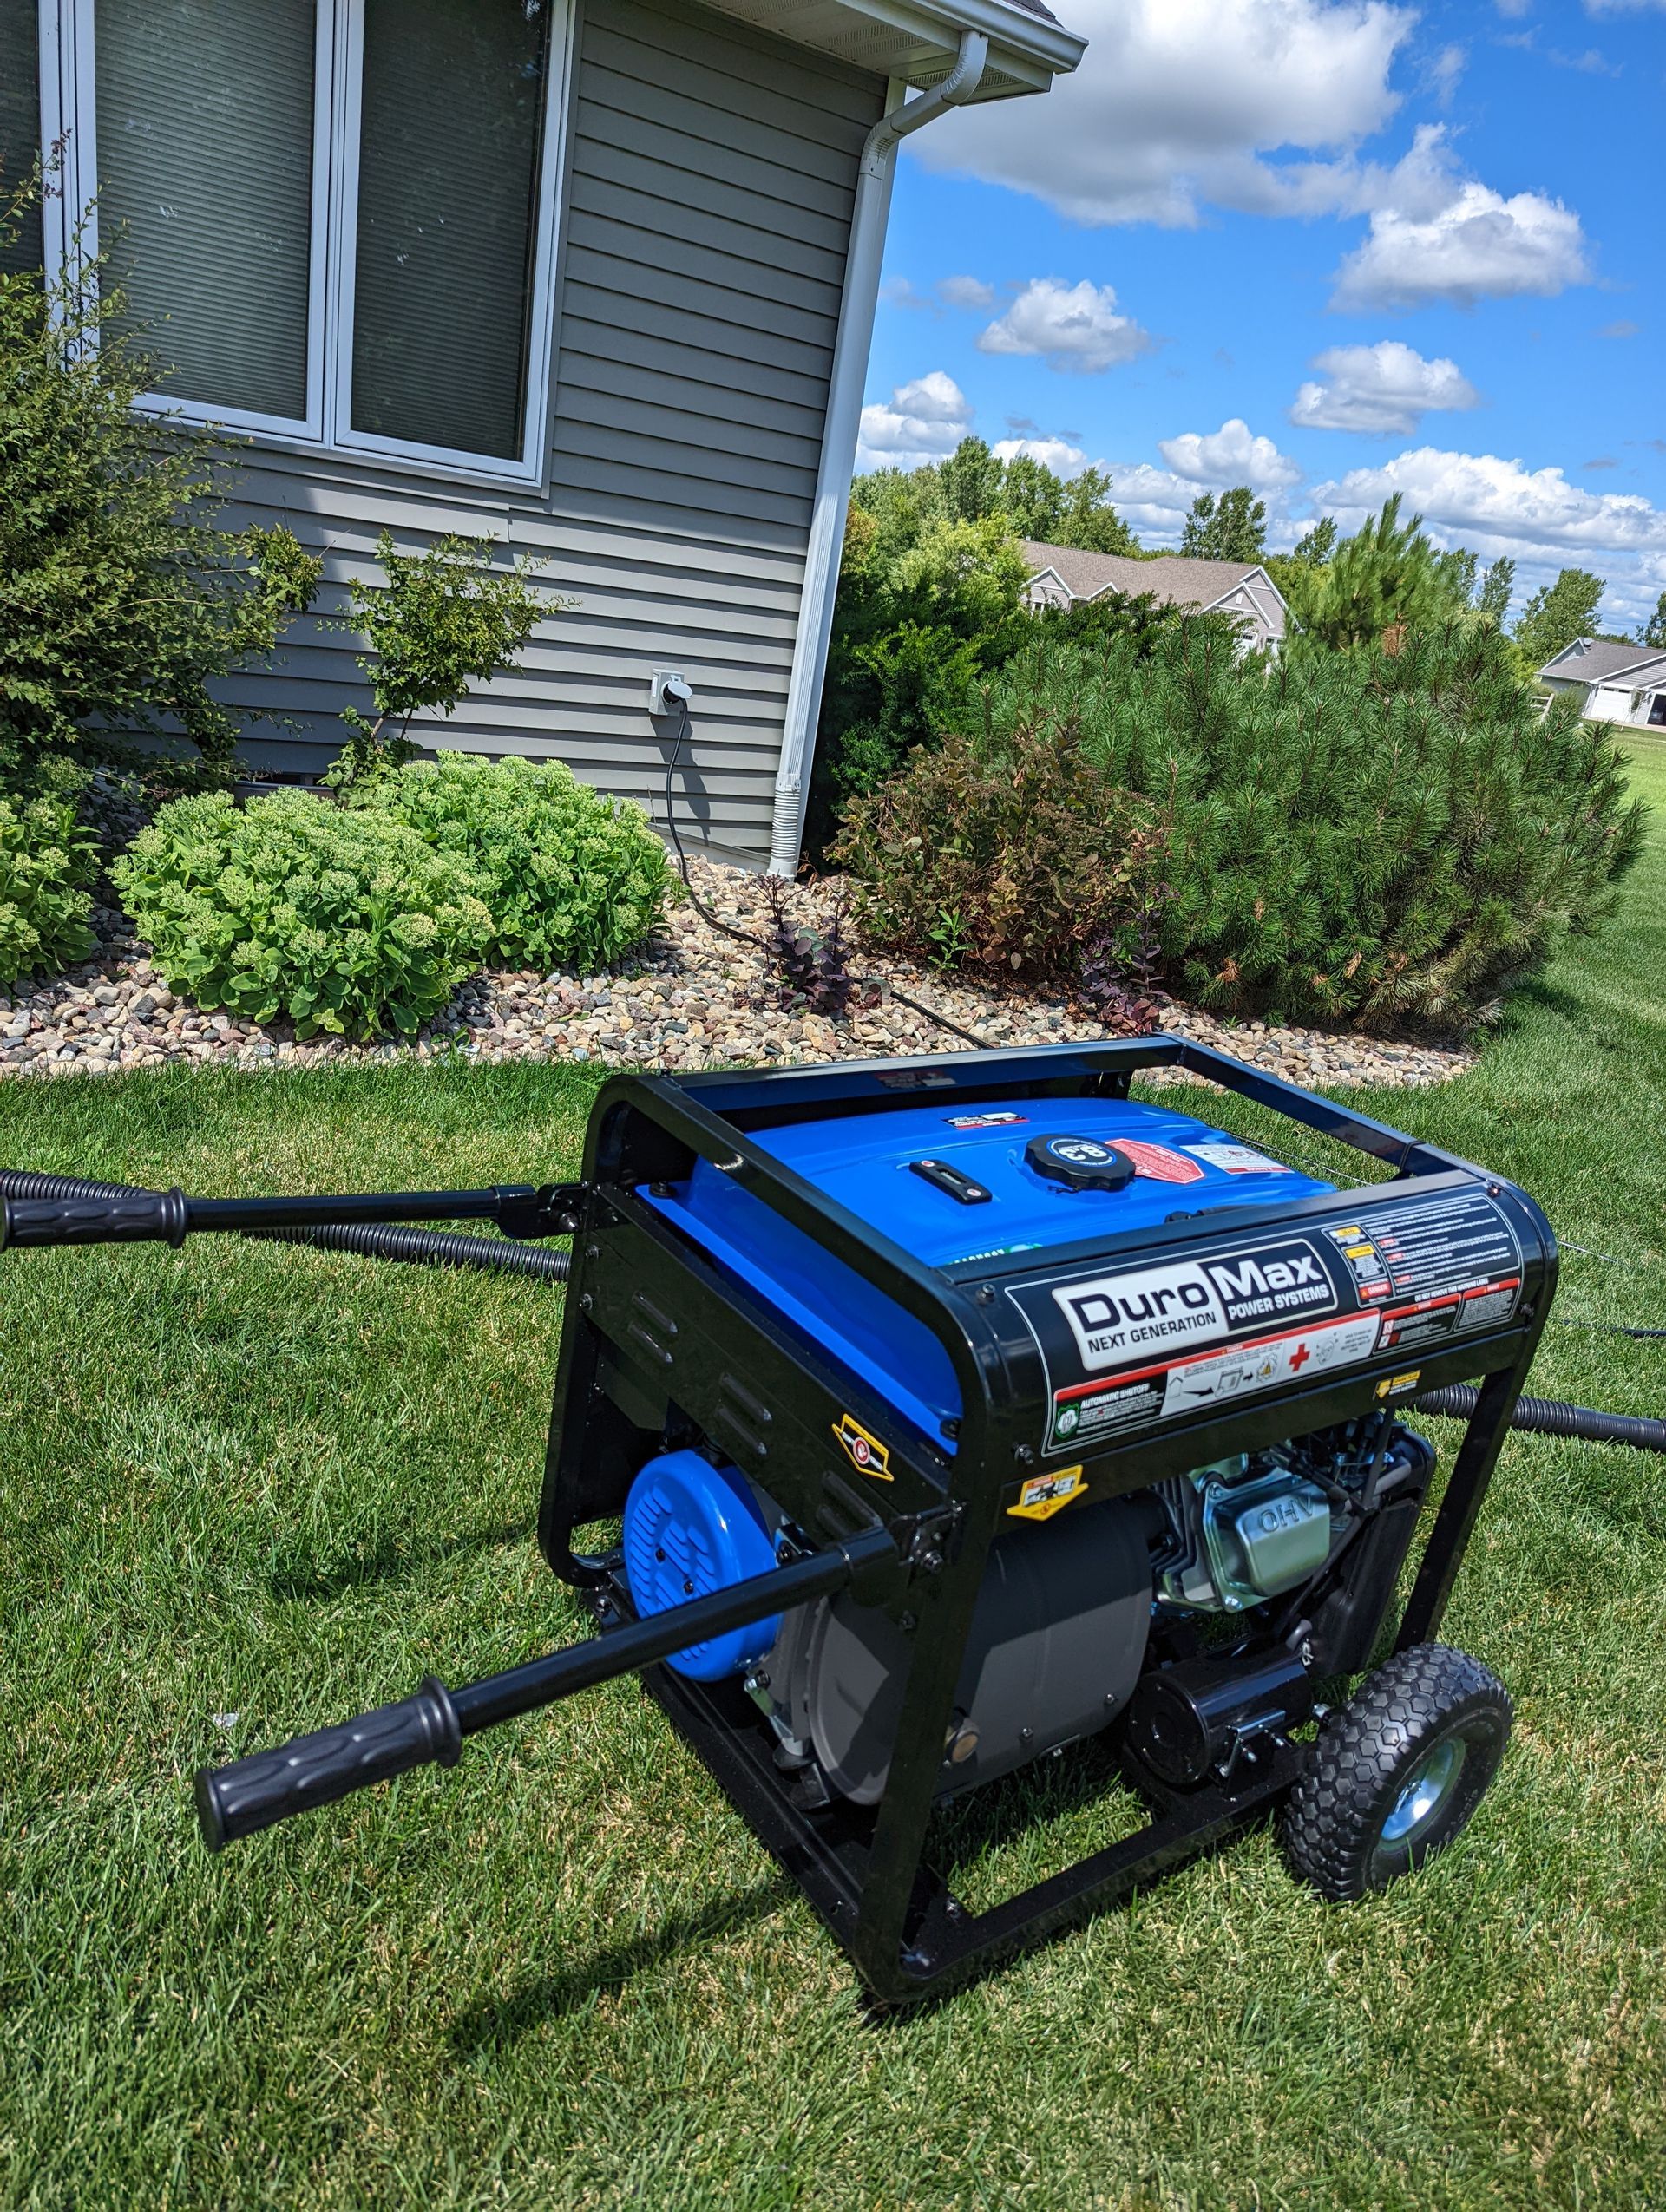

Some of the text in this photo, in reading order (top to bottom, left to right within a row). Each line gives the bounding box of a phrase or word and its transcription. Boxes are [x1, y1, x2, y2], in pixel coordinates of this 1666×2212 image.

[1058, 1143, 1108, 1162] 8.3
[1228, 1283, 1330, 1321] POWER SYSTEMS
[1087, 1311, 1217, 1353] NEXT GENERATION
[1080, 1383, 1151, 1410] AUTOMATIC SHUTOFF
[1259, 1492, 1313, 1533] OHV
